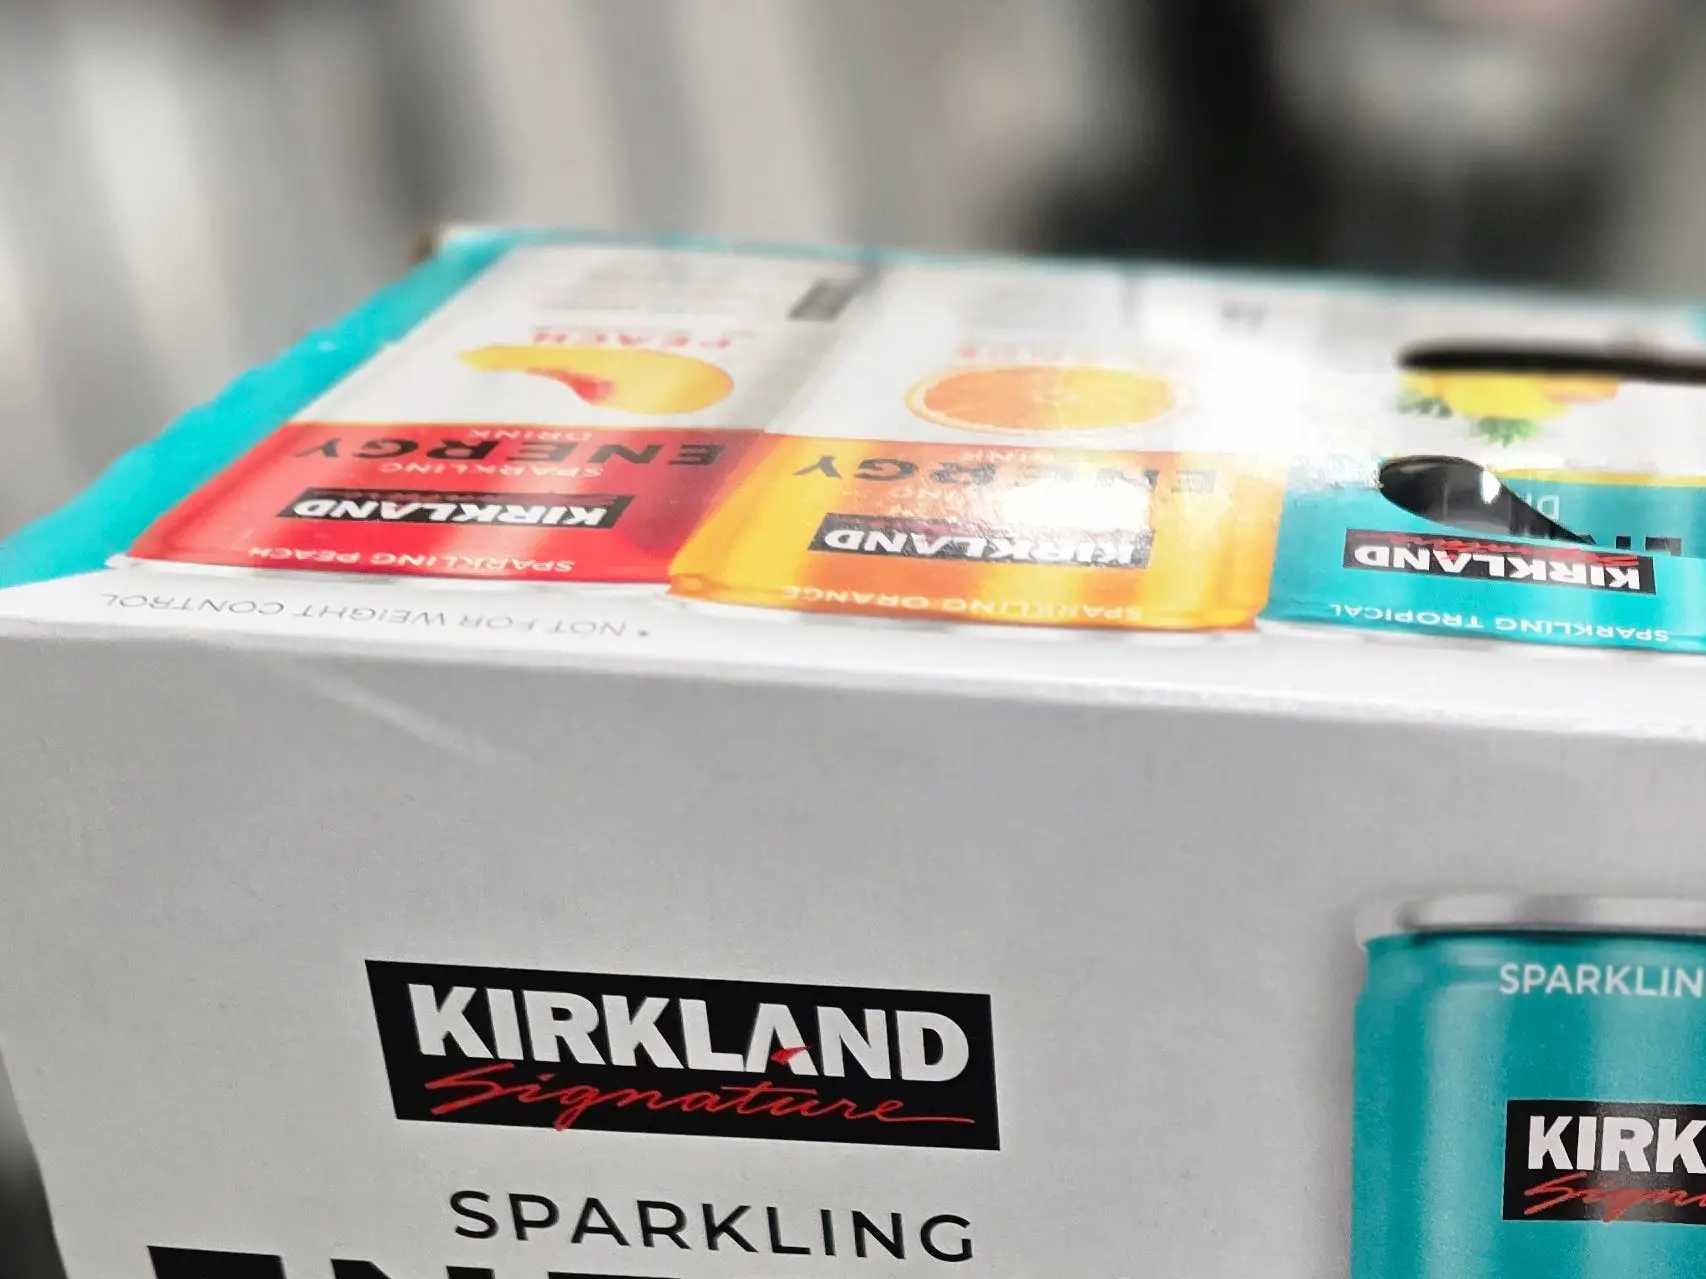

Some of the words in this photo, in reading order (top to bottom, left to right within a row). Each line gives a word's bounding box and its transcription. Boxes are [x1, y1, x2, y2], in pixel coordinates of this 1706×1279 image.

[469, 428, 594, 442] DRINK
[291, 437, 727, 466] ENERGY
[378, 461, 605, 478] SPARKLING
[292, 499, 607, 526] KIRKLAND
[248, 546, 361, 565] PEACH
[824, 528, 1134, 566] KIRKLAND
[369, 551, 575, 574] SPARKLING
[1354, 544, 1641, 591] KIRKLAND
[101, 592, 285, 616] CONTROL
[781, 585, 931, 612] ORANGE
[947, 594, 1144, 620] SPARKLING
[292, 604, 446, 627] WEIGHT
[459, 614, 534, 633] FOR
[554, 620, 628, 637] NOT
[1328, 603, 1485, 630] TROPICAL
[1494, 618, 1670, 643] SPARKLING
[408, 983, 970, 1082] KIRKLAND
[424, 1061, 976, 1132] Signature
[448, 1189, 974, 1264] SPARKLING
